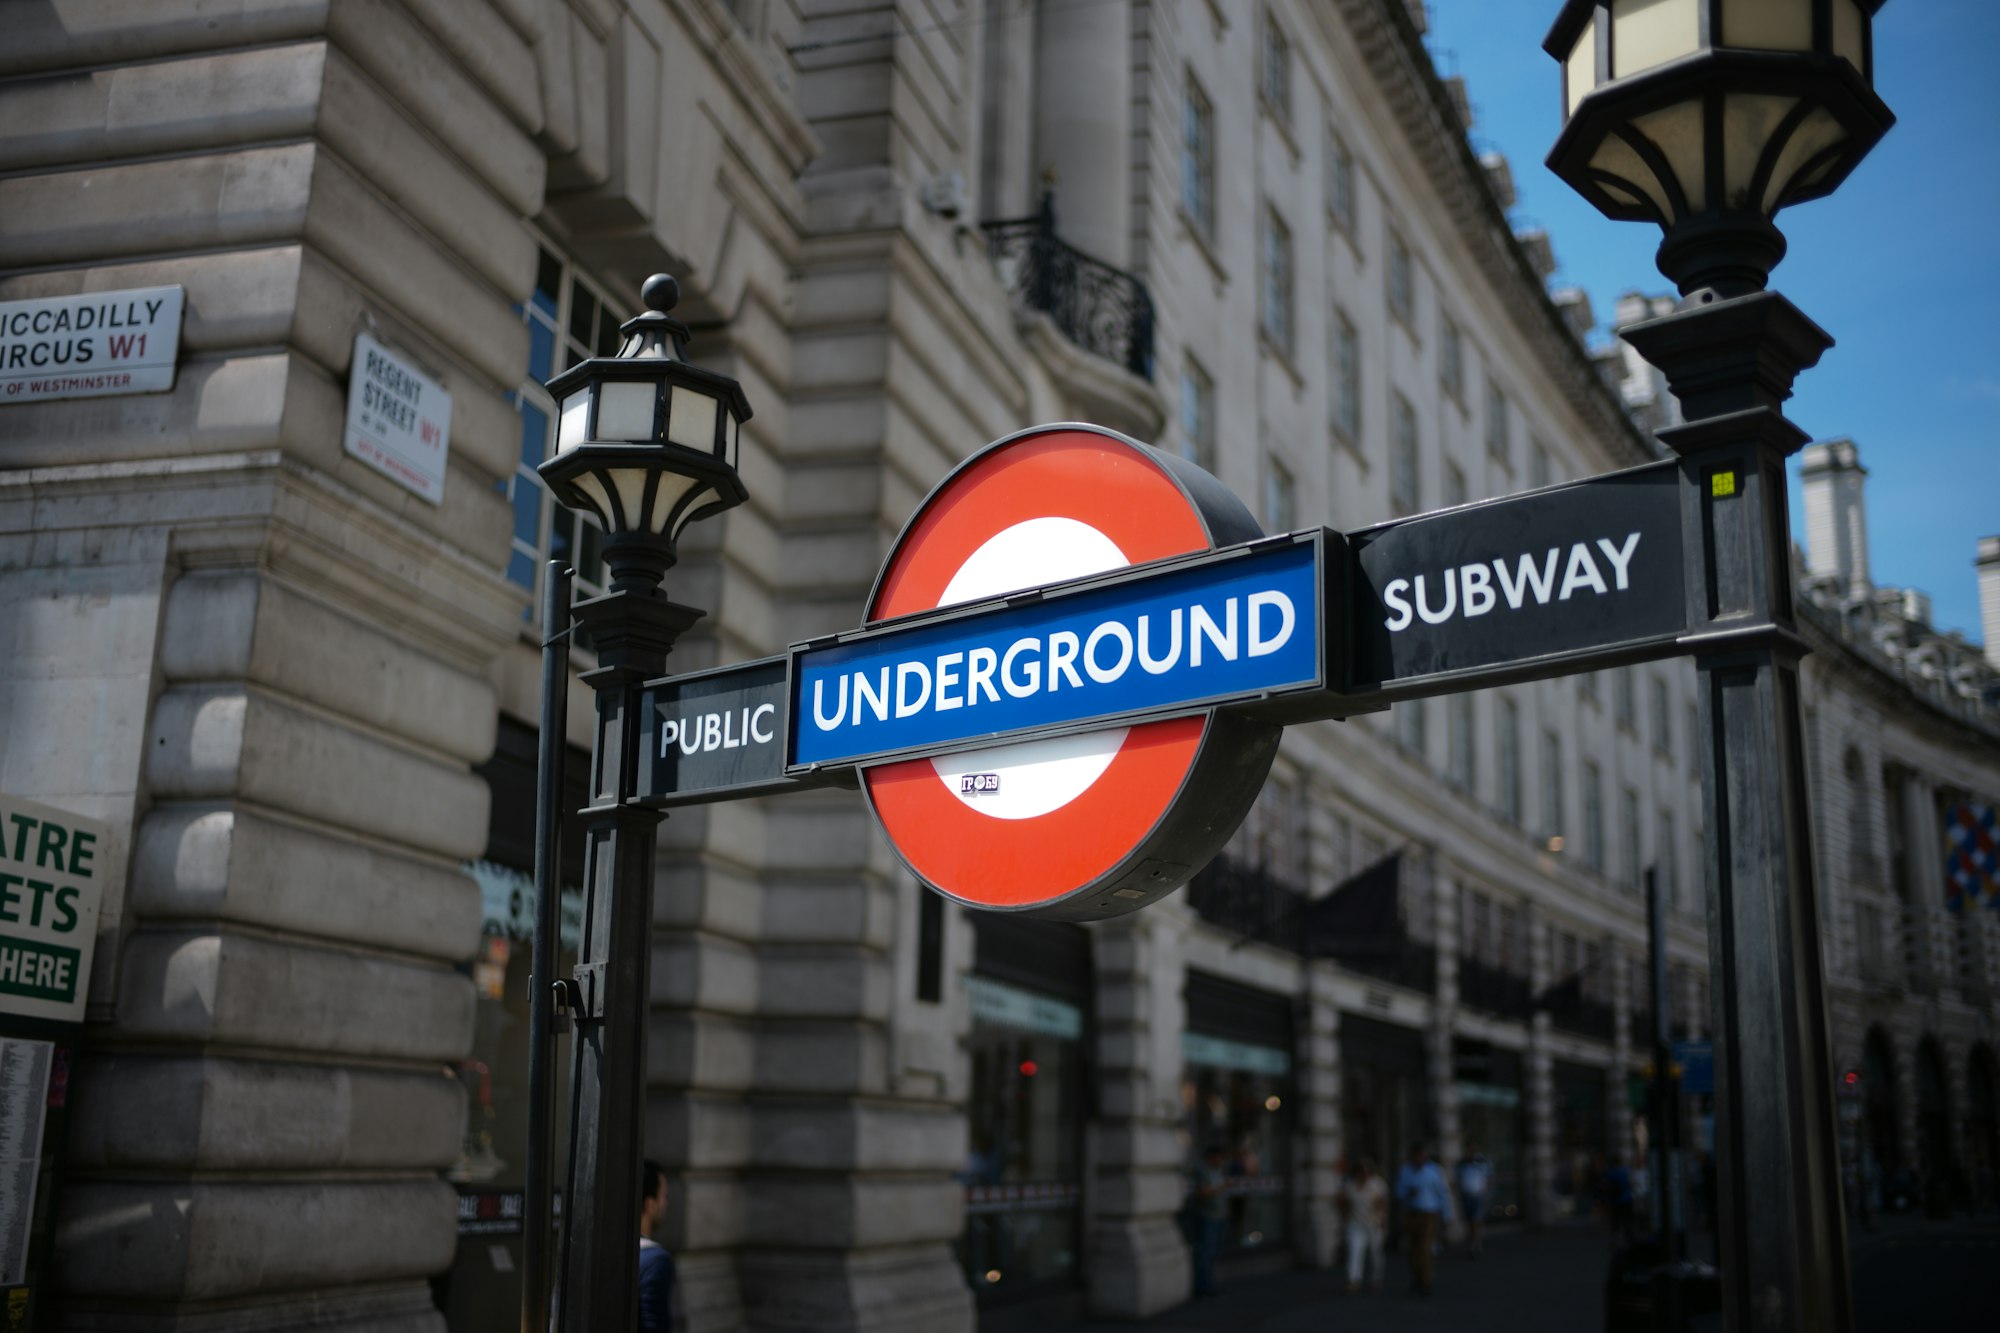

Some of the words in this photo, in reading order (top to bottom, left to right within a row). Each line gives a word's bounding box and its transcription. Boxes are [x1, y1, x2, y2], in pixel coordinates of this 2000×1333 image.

[108, 332, 148, 360] W1
[7, 382, 25, 396] OF
[30, 373, 132, 394] WESTMINSTER
[365, 349, 423, 406] REGENT
[362, 378, 417, 434] STREET
[420, 416, 442, 450] W1
[1383, 532, 1642, 632] SUBWAY
[812, 589, 1297, 732] UNDERGROUND
[660, 703, 775, 758] PUBLIC
[0, 946, 72, 991] HERE
